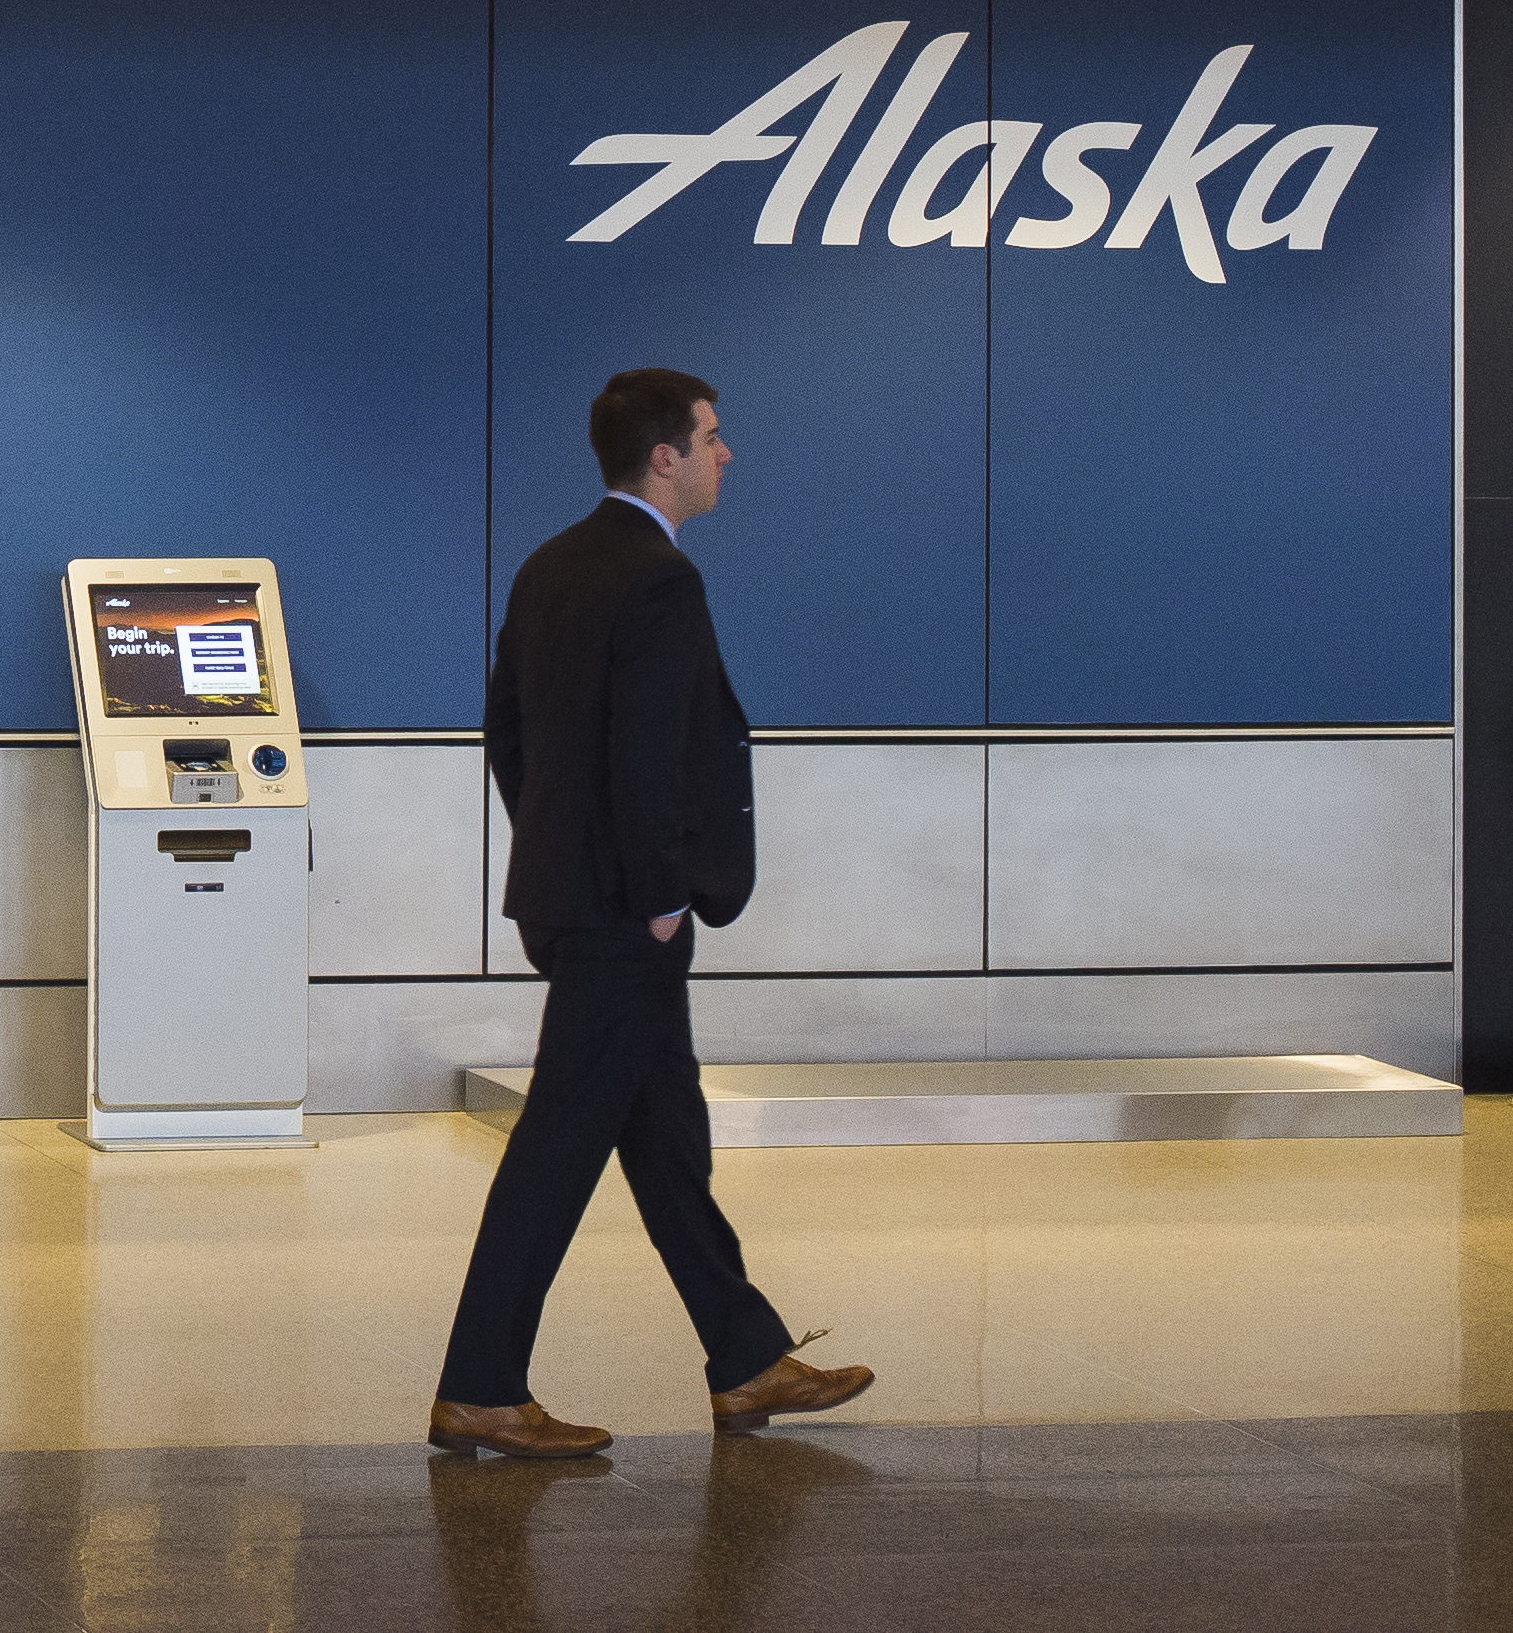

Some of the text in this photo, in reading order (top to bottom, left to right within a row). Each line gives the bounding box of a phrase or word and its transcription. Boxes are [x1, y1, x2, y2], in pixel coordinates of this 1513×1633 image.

[565, 20, 1379, 285] Alaska
[107, 625, 147, 640] Begin
[109, 641, 174, 655] your trip.
